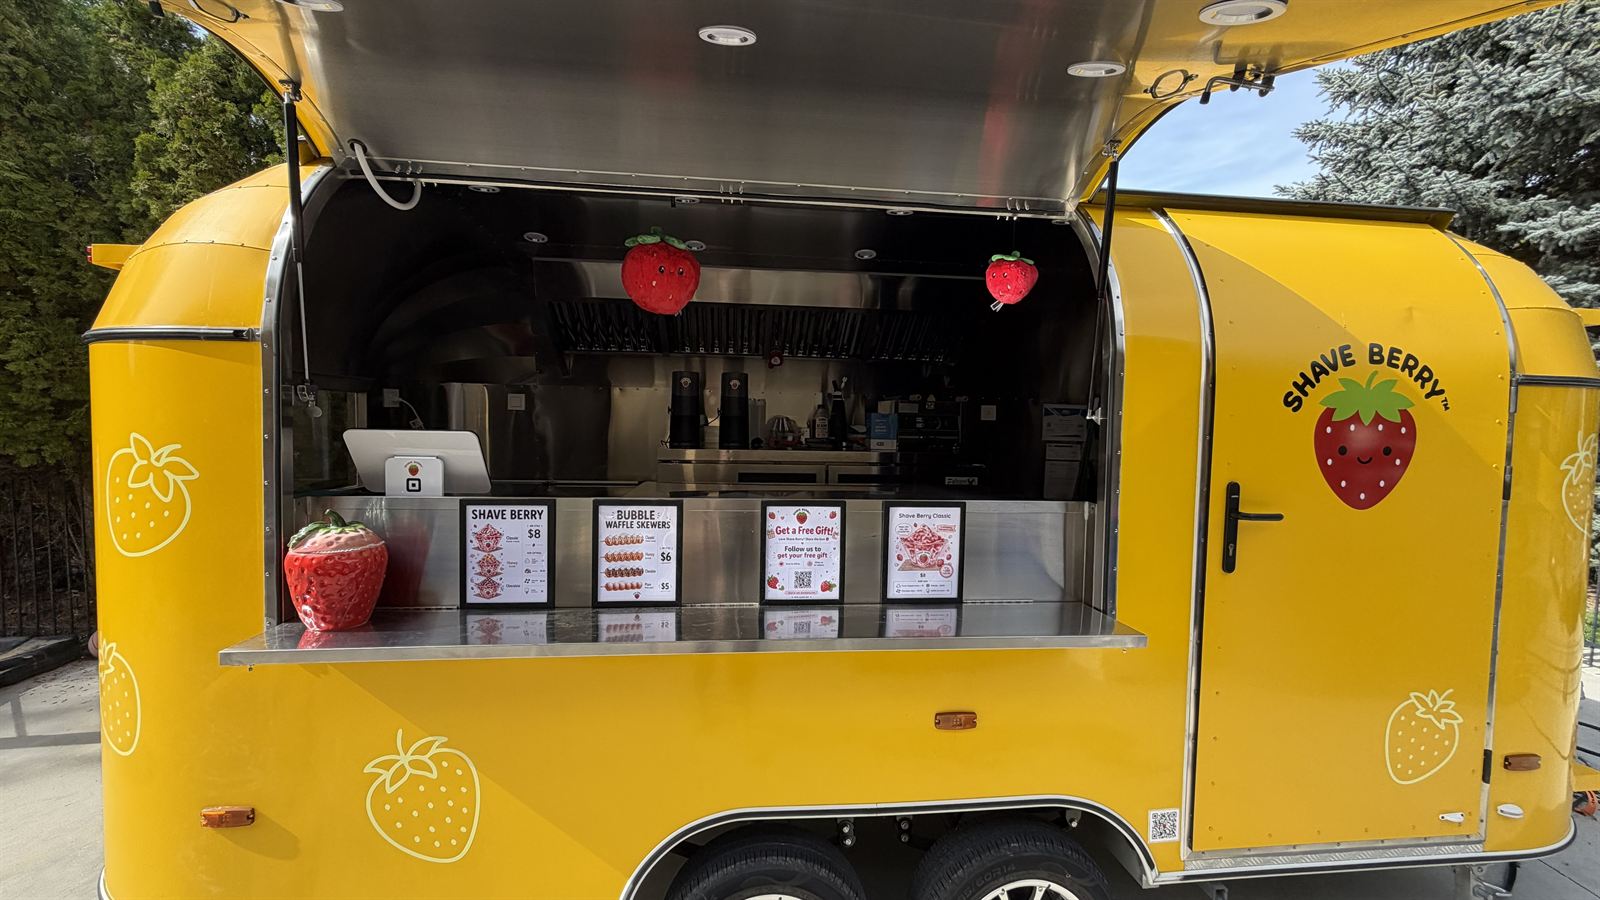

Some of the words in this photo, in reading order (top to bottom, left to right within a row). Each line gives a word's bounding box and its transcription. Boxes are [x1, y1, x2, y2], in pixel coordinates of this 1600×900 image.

[1282, 344, 1356, 413] SHAVE
[1368, 343, 1446, 400] BERRY
[471, 509, 507, 520] SHAVE
[510, 509, 544, 520] BERRY
[616, 510, 656, 520] BUBBLE
[605, 521, 635, 529] WAFFLE
[636, 521, 671, 529] SKEWERS
[527, 529, 541, 539] $8
[775, 526, 790, 535] Get
[798, 526, 814, 535] Free
[815, 526, 834, 536] Gift!
[660, 551, 672, 562] $6
[816, 552, 828, 560] gift
[661, 582, 670, 590] $5
